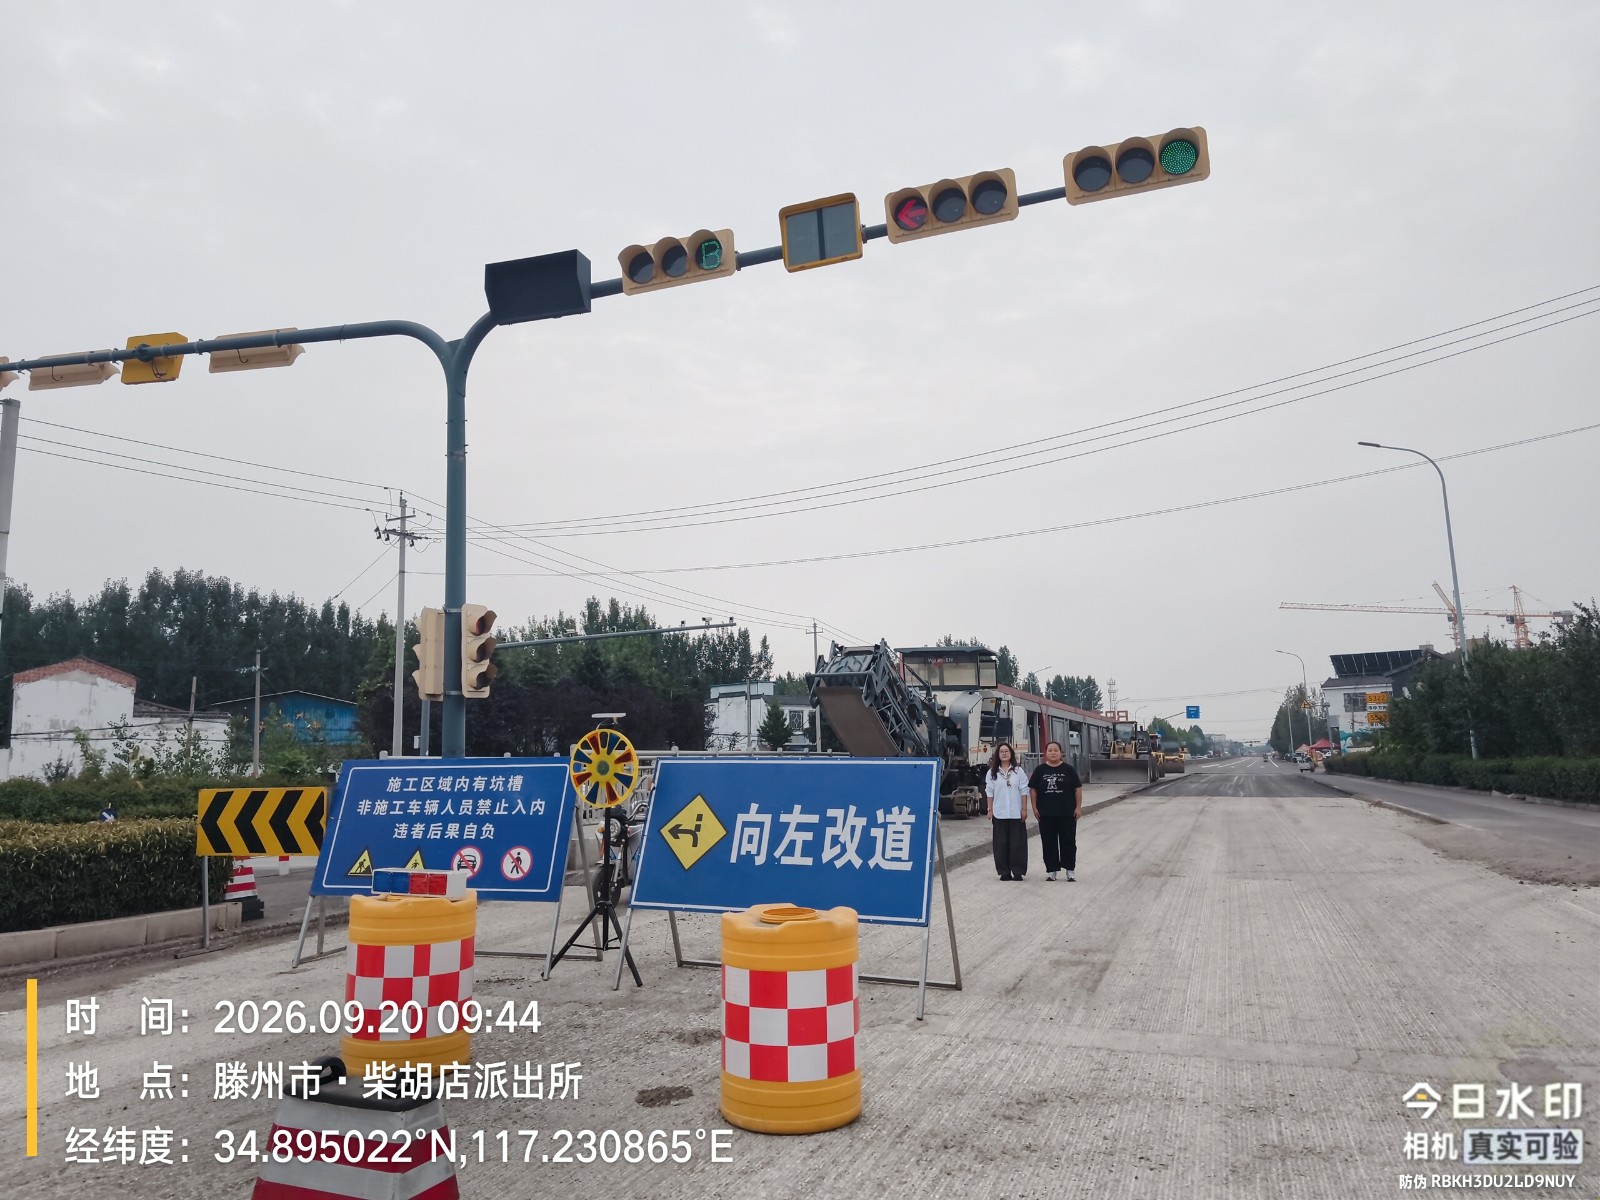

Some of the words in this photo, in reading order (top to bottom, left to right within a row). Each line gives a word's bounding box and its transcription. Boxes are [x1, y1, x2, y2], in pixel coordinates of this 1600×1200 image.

[386, 775, 523, 792] 施工区域内有坑槽
[357, 799, 546, 816] 非施工车辆人员禁止入内
[392, 822, 496, 840] 违者后果自负
[730, 803, 916, 871] 向左改道
